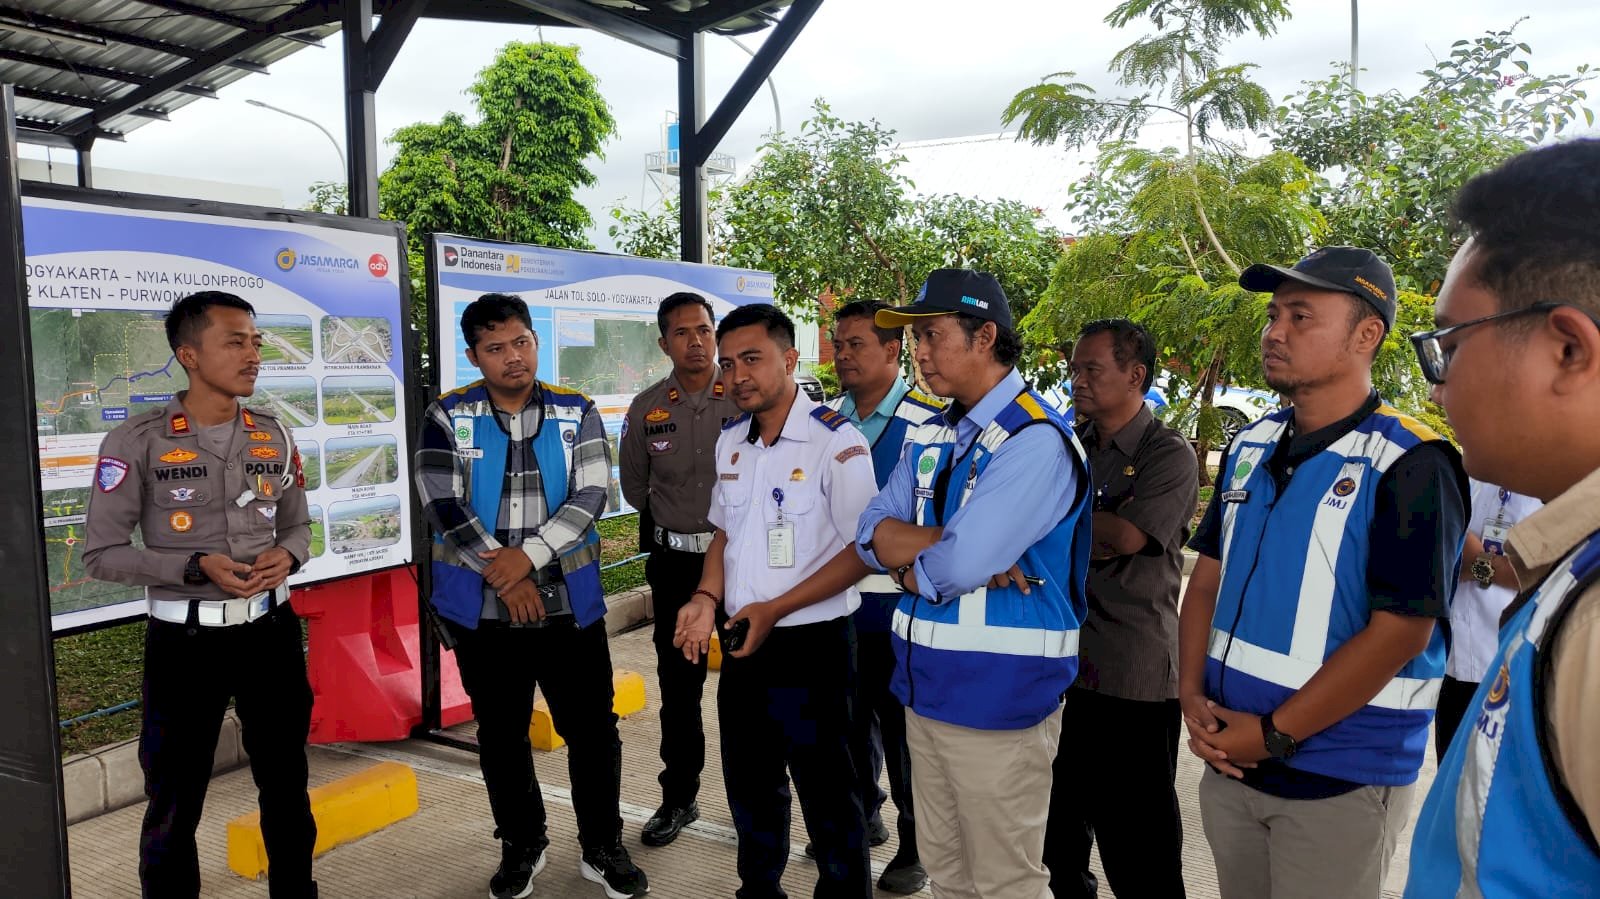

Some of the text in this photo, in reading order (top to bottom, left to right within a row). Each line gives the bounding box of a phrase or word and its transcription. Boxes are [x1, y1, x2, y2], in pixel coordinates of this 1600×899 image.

[461, 247, 505, 261] Danantara
[299, 254, 360, 270] JASAMARGA
[461, 260, 502, 272] Indonesia
[25, 264, 119, 281] OGYAKARTA
[137, 270, 169, 284] NYIA
[174, 272, 264, 289] KULONPROGO
[38, 285, 102, 300] KLATEN
[545, 289, 569, 300] JALAN
[572, 291, 584, 301] TOL
[587, 292, 606, 303] SOLO
[612, 294, 652, 305] YOGYAKARTA
[155, 465, 208, 482] WENDI
[245, 463, 283, 475] POLRI
[1323, 496, 1347, 510] JMJ
